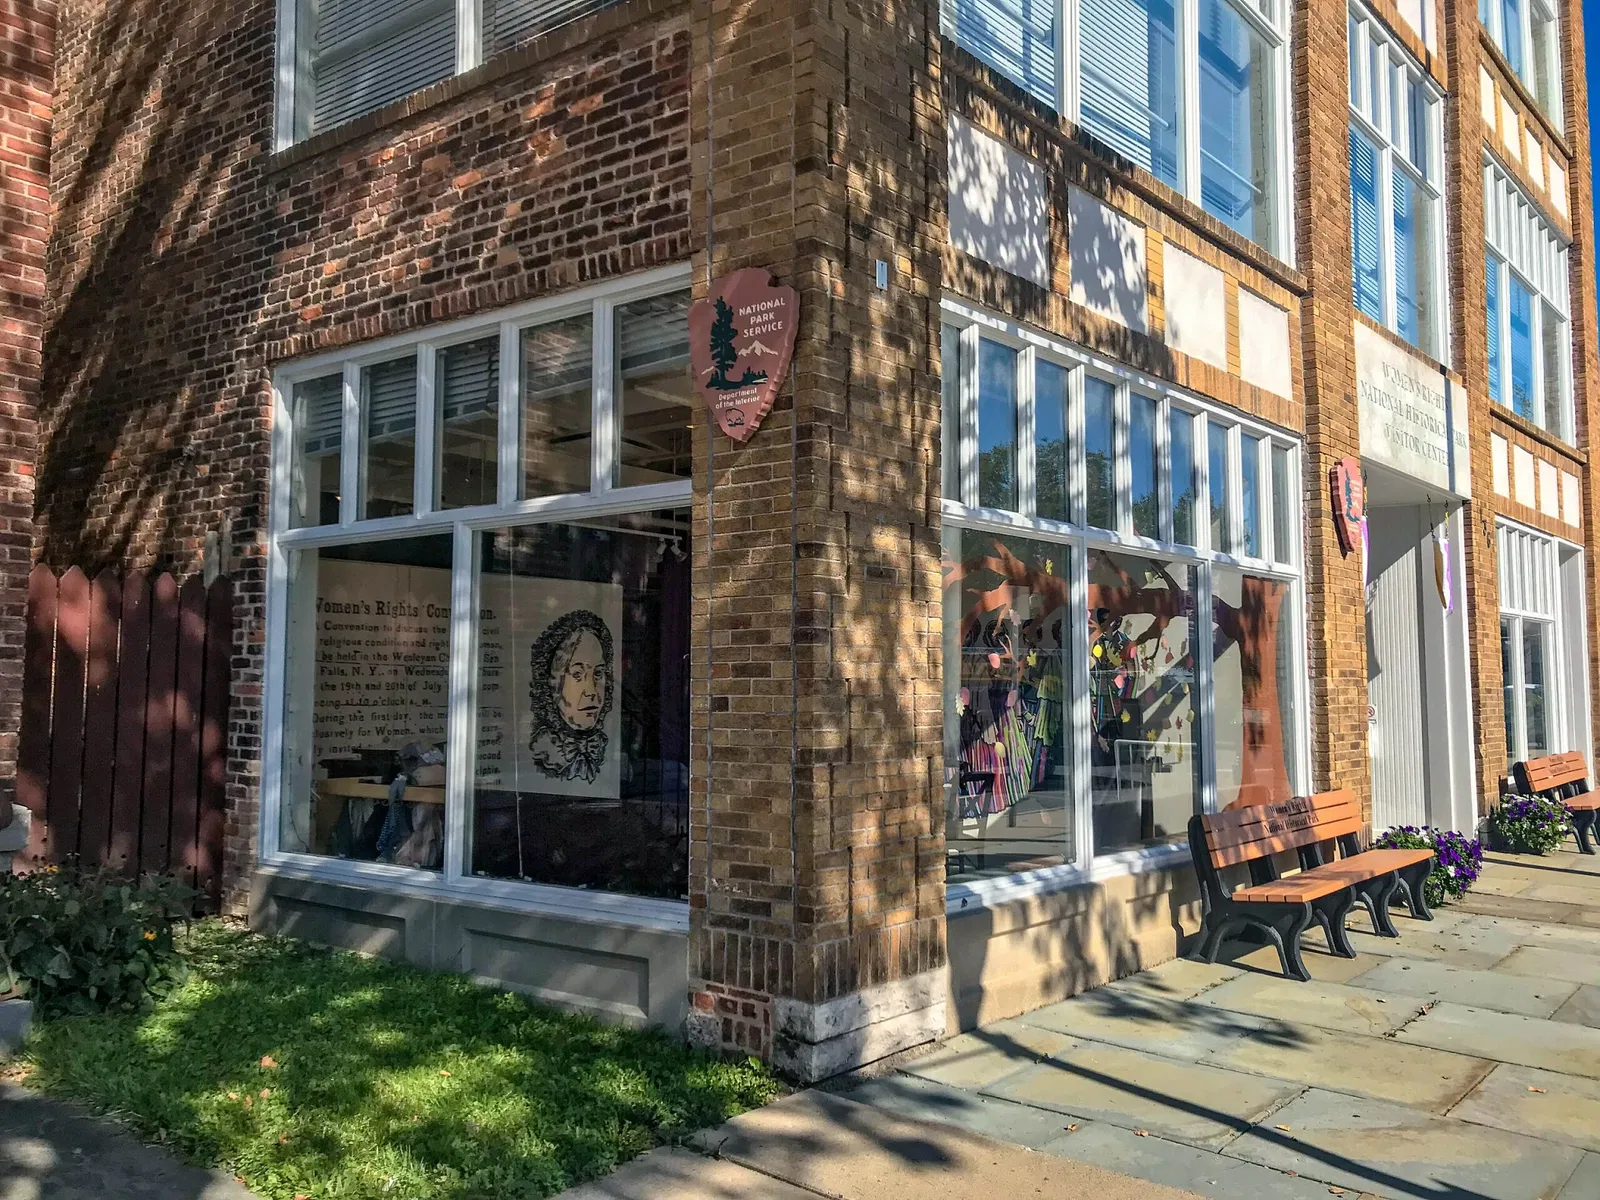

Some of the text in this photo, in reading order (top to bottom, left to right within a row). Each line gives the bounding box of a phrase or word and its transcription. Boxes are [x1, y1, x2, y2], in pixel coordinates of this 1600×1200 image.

[739, 297, 786, 316] NATIONAL
[750, 311, 775, 325] PARK
[743, 320, 783, 338] SERVICE
[718, 387, 757, 401] Department
[1421, 384, 1445, 411] RIGHT
[715, 395, 760, 410] of the Interior
[1360, 379, 1467, 449] NATIONAL HISTORICA ARK
[1384, 423, 1449, 466] VISITOR CENTE
[376, 600, 419, 619] Rights
[324, 620, 380, 632] Convention
[432, 625, 447, 634] the
[319, 635, 362, 649] religious
[321, 650, 333, 661] be
[336, 651, 358, 661] held
[360, 653, 370, 661] in
[373, 652, 388, 661] the
[393, 652, 436, 665] Wesleyan
[352, 666, 365, 677] N.
[388, 669, 398, 677] on
[320, 681, 336, 692] the
[341, 681, 361, 692] 19th
[365, 681, 382, 691] and
[407, 680, 417, 692] of
[422, 680, 442, 694] July
[312, 712, 345, 726] During
[348, 711, 365, 722] the
[371, 711, 390, 722] first
[419, 711, 434, 720] the
[358, 726, 371, 737] for
[418, 725, 444, 735] which
[1263, 820, 1285, 834] National
[1307, 812, 1320, 825] Park
